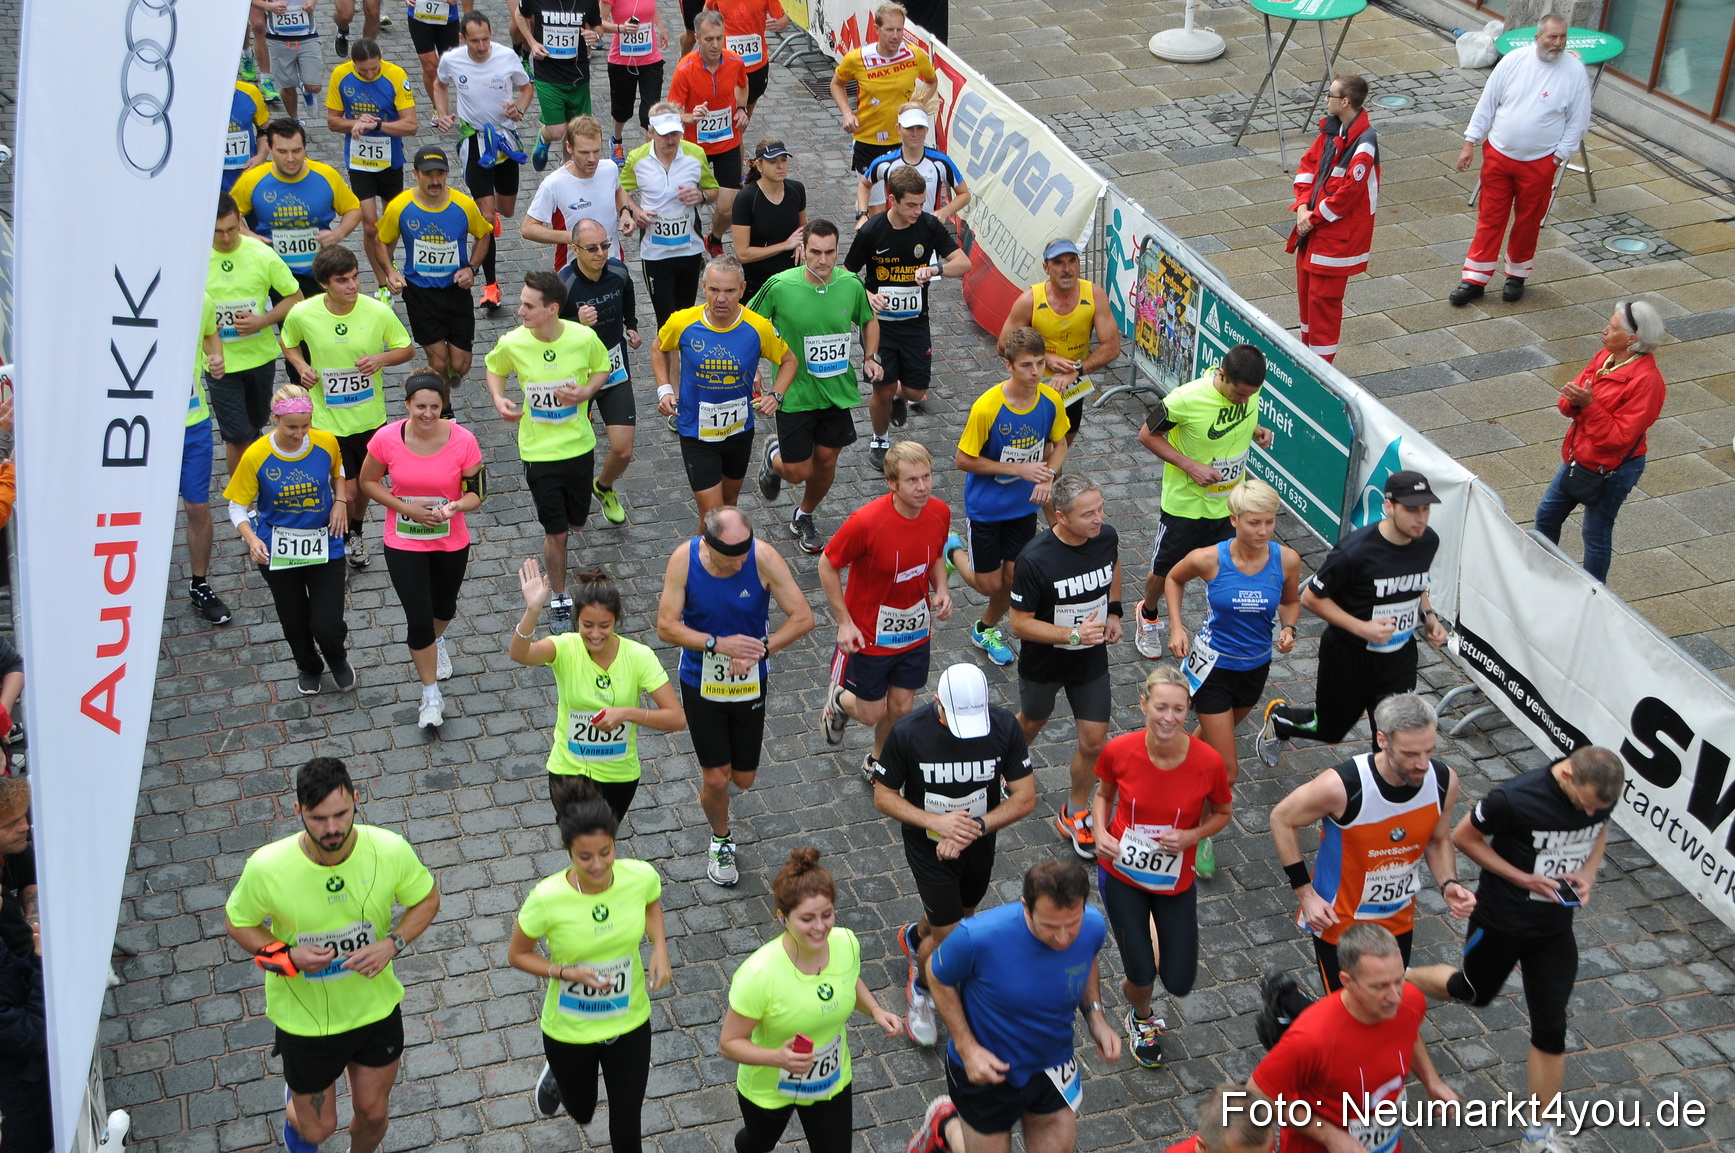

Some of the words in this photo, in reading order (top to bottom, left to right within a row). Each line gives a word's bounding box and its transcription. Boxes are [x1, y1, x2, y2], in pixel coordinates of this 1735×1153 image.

[276, 12, 307, 27] 2551
[541, 11, 584, 25] THULE
[546, 34, 576, 48] 2151
[622, 31, 649, 45] 2897
[730, 41, 760, 56] 3343
[867, 68, 890, 80] MAX
[893, 60, 917, 73] BÖGL
[700, 115, 731, 132] 2271
[358, 144, 384, 159] 215
[654, 220, 688, 236] 3307
[278, 237, 318, 255] 3406
[418, 250, 456, 266] 2677
[882, 295, 918, 312] 2910
[809, 344, 847, 362] 2554
[102, 264, 161, 469] BKK
[818, 363, 838, 373] Daniel
[327, 374, 370, 395] 2755
[709, 409, 740, 429] 171
[1216, 402, 1249, 426] RUN
[1258, 396, 1294, 438] erheit
[1264, 467, 1289, 496] 09181
[1288, 490, 1309, 514] 6352
[409, 525, 435, 534] Marina
[277, 536, 323, 557] 5104
[1053, 564, 1112, 599] THULE
[80, 511, 142, 736] Audi
[882, 612, 926, 634] 2337
[1186, 651, 1208, 675] 67
[705, 684, 756, 696] Hans-Werner
[1460, 635, 1508, 687] istungen,
[1507, 678, 1525, 701] die
[1525, 695, 1576, 753] verbinden
[579, 745, 615, 757] Vanessa
[918, 758, 997, 784] THULE
[1532, 822, 1604, 850] THULE
[1121, 845, 1178, 874] 3367
[1367, 873, 1416, 904] 2582
[577, 1000, 611, 1013] Nadine
